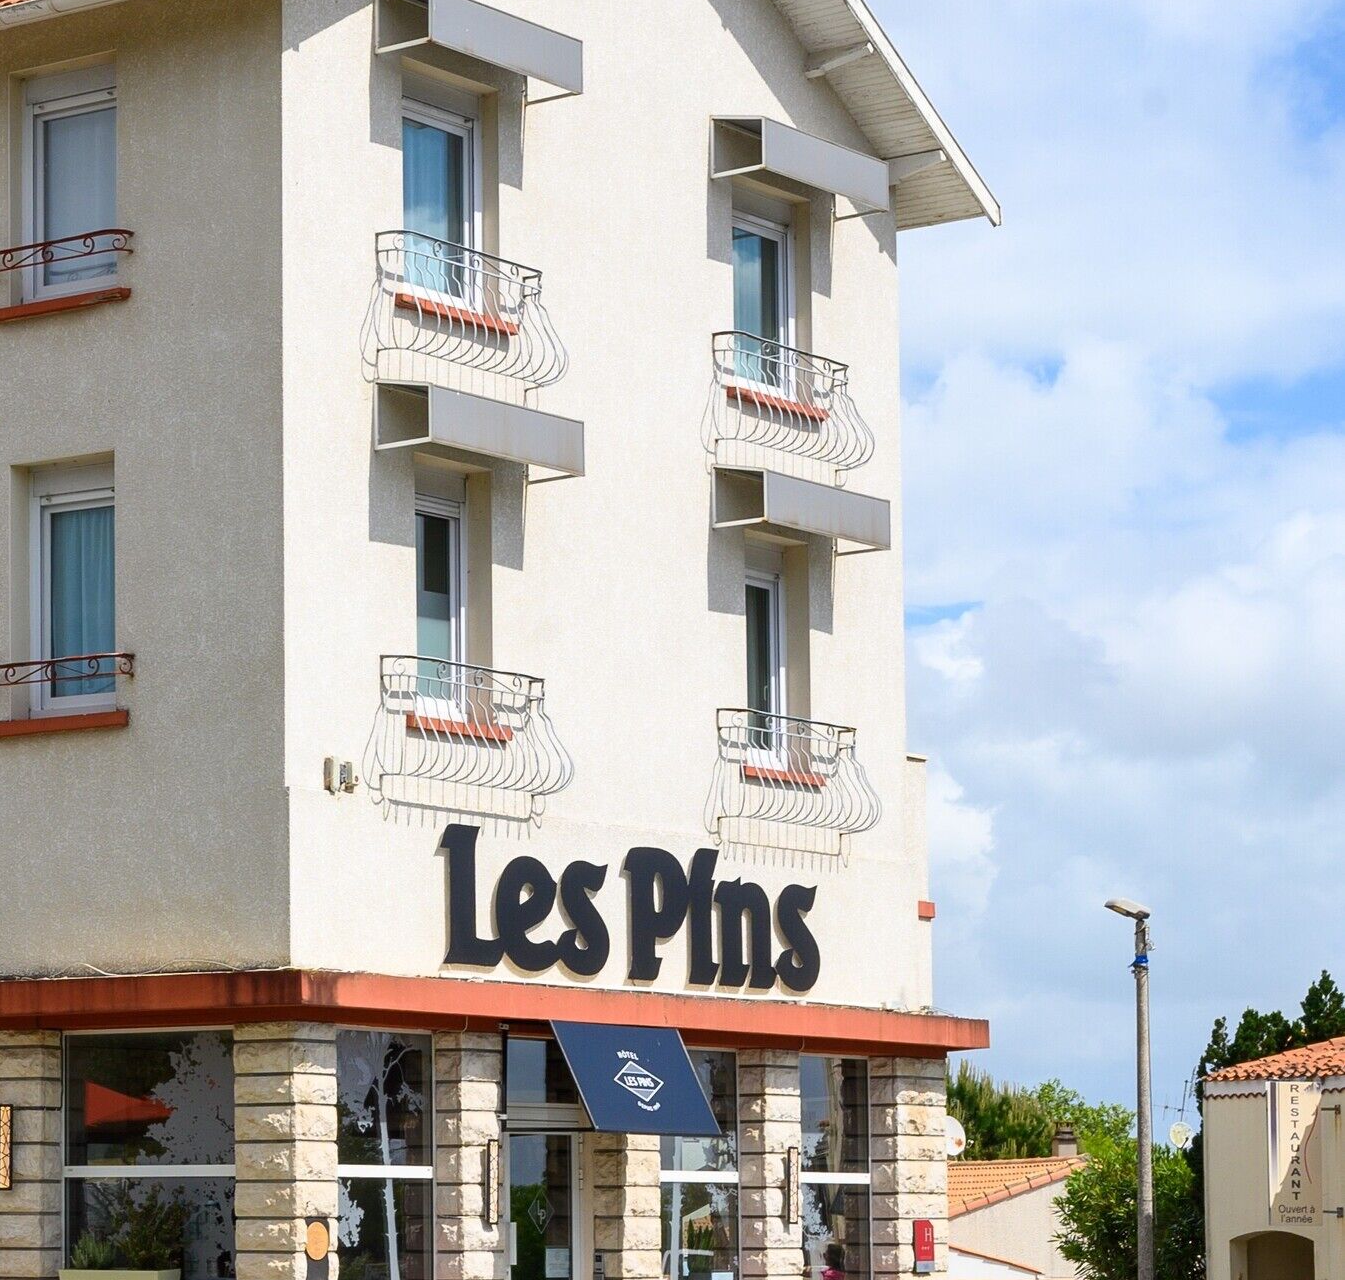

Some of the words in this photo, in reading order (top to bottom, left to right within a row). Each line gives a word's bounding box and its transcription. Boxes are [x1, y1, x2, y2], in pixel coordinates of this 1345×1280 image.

[440, 823, 610, 976] Les
[623, 847, 821, 992] Pins
[623, 1075, 638, 1087] LES
[637, 1076, 655, 1088] PINS
[1290, 1084, 1301, 1200] RESTAURANT
[1278, 1205, 1307, 1214] Ouvert
[1309, 1205, 1316, 1214] à
[1280, 1214, 1313, 1224] l'année
[924, 1227, 932, 1242] H
